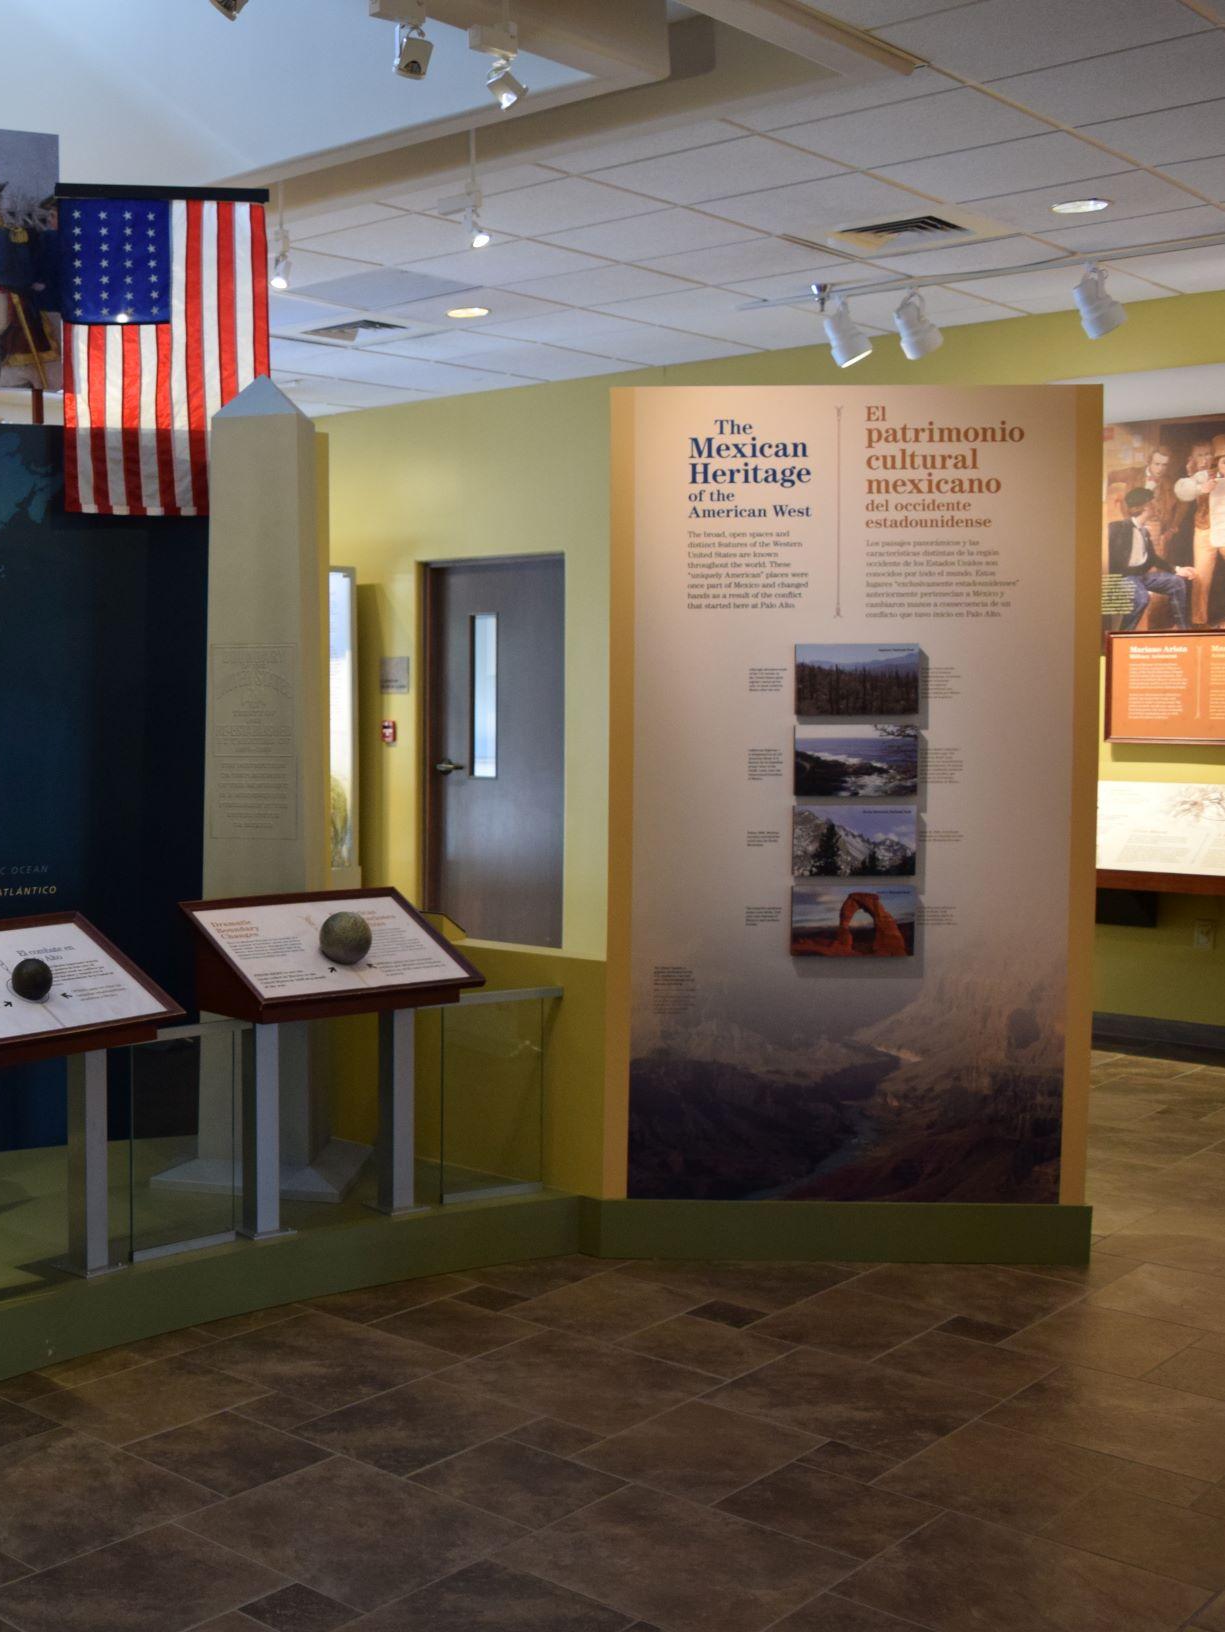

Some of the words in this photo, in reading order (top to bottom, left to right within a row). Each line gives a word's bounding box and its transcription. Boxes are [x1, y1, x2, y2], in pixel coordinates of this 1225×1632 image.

[865, 405, 886, 422] El
[714, 419, 752, 435] The
[865, 421, 1025, 449] patrimonio
[688, 437, 808, 459] Mexican
[866, 448, 978, 470] cultural
[688, 462, 812, 488] Heritage
[865, 473, 1001, 494] mexicano
[688, 489, 707, 502] of
[710, 490, 734, 502] the
[688, 506, 767, 518] American
[773, 505, 812, 518] West
[865, 499, 888, 512] del
[895, 499, 971, 512] occidente
[865, 516, 992, 528] estadounidense
[10, 865, 48, 875] OCEAN
